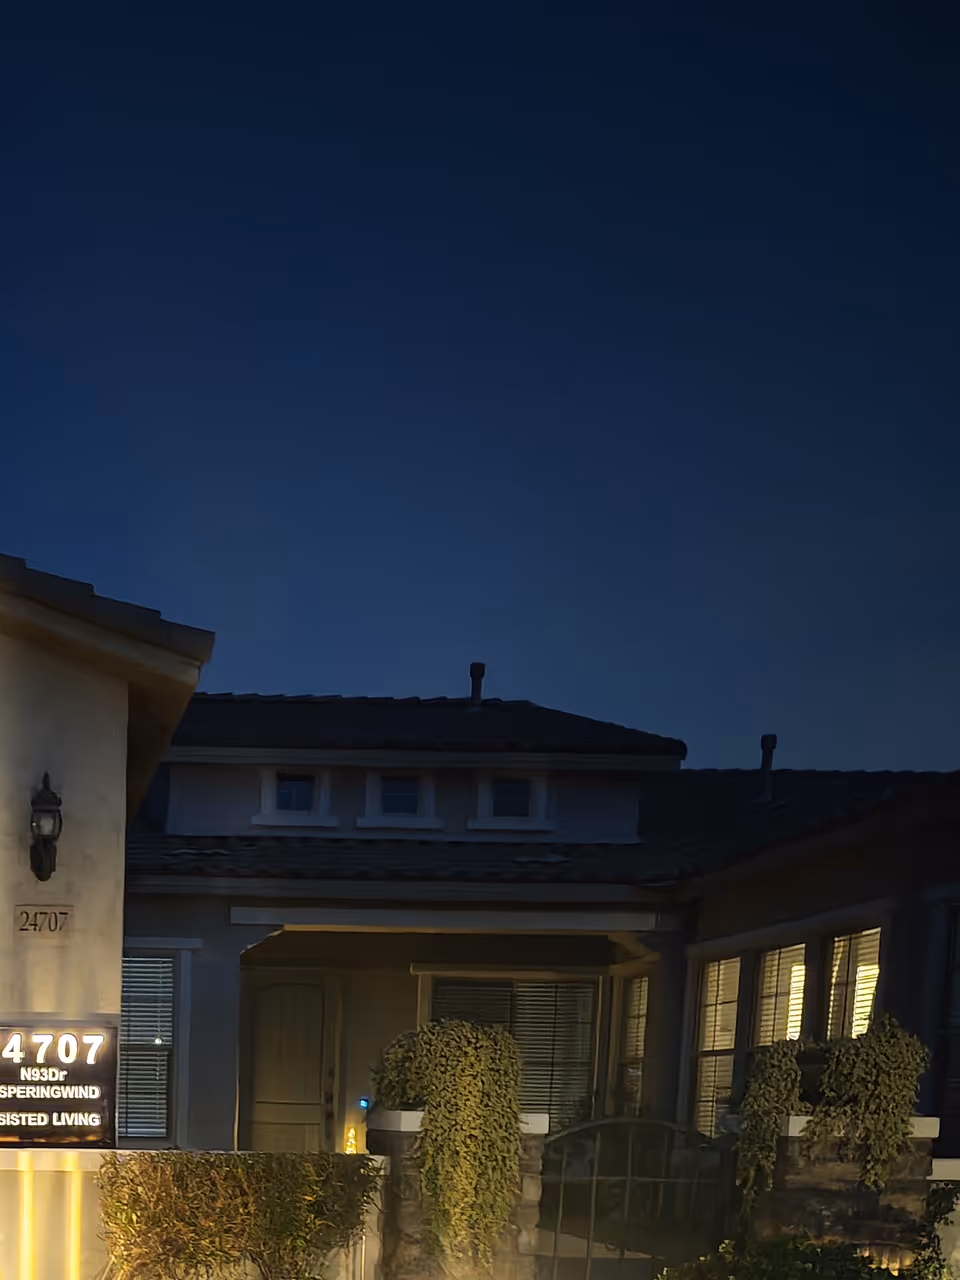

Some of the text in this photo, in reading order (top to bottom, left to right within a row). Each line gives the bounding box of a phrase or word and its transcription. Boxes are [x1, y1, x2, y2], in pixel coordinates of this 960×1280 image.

[19, 911, 69, 933] 24707
[20, 1067, 68, 1081] N93Dr
[52, 1112, 101, 1127] LIVING
